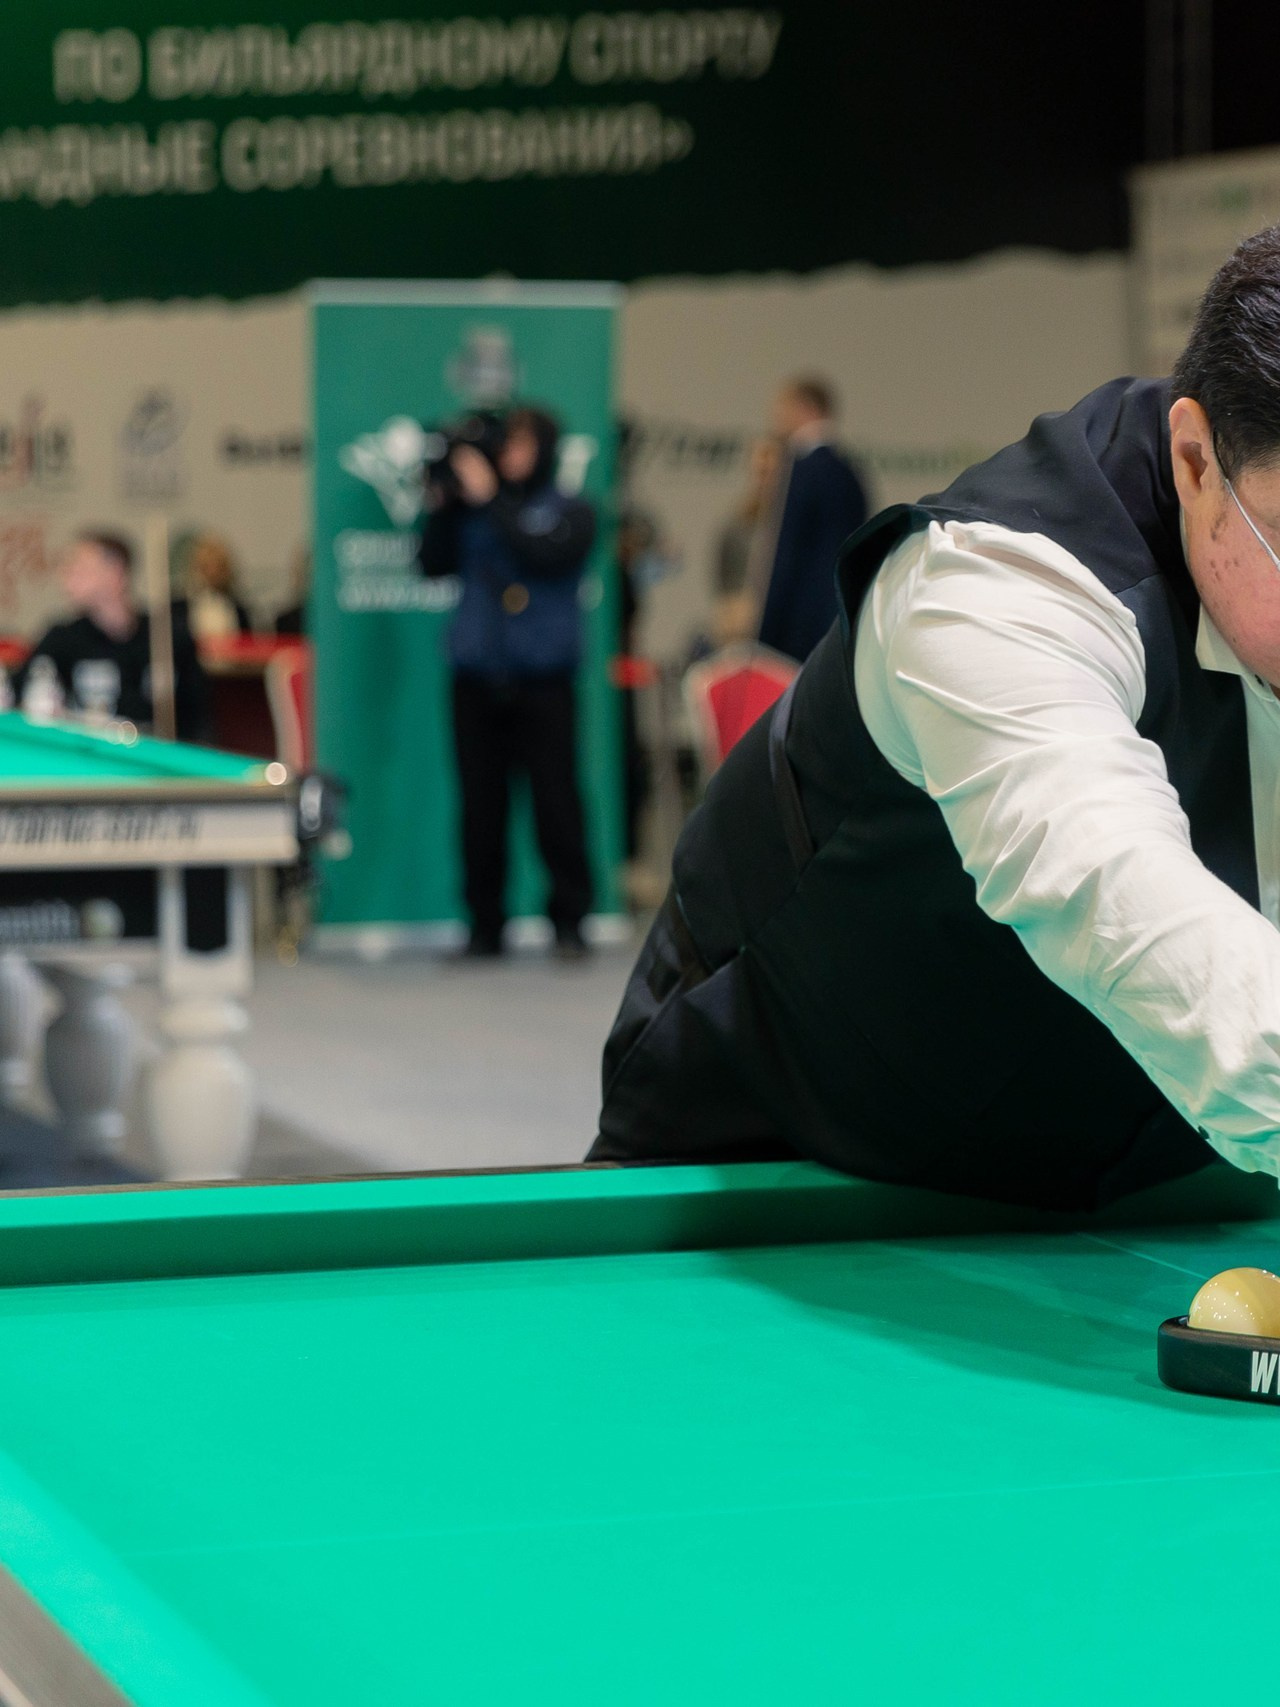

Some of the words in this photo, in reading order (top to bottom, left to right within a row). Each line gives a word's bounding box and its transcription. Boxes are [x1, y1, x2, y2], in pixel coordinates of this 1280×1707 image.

[54, 29, 141, 102] ПО
[148, 17, 566, 100] БИЛЬЯРДНОМУ
[570, 10, 781, 84] СПОРТУ
